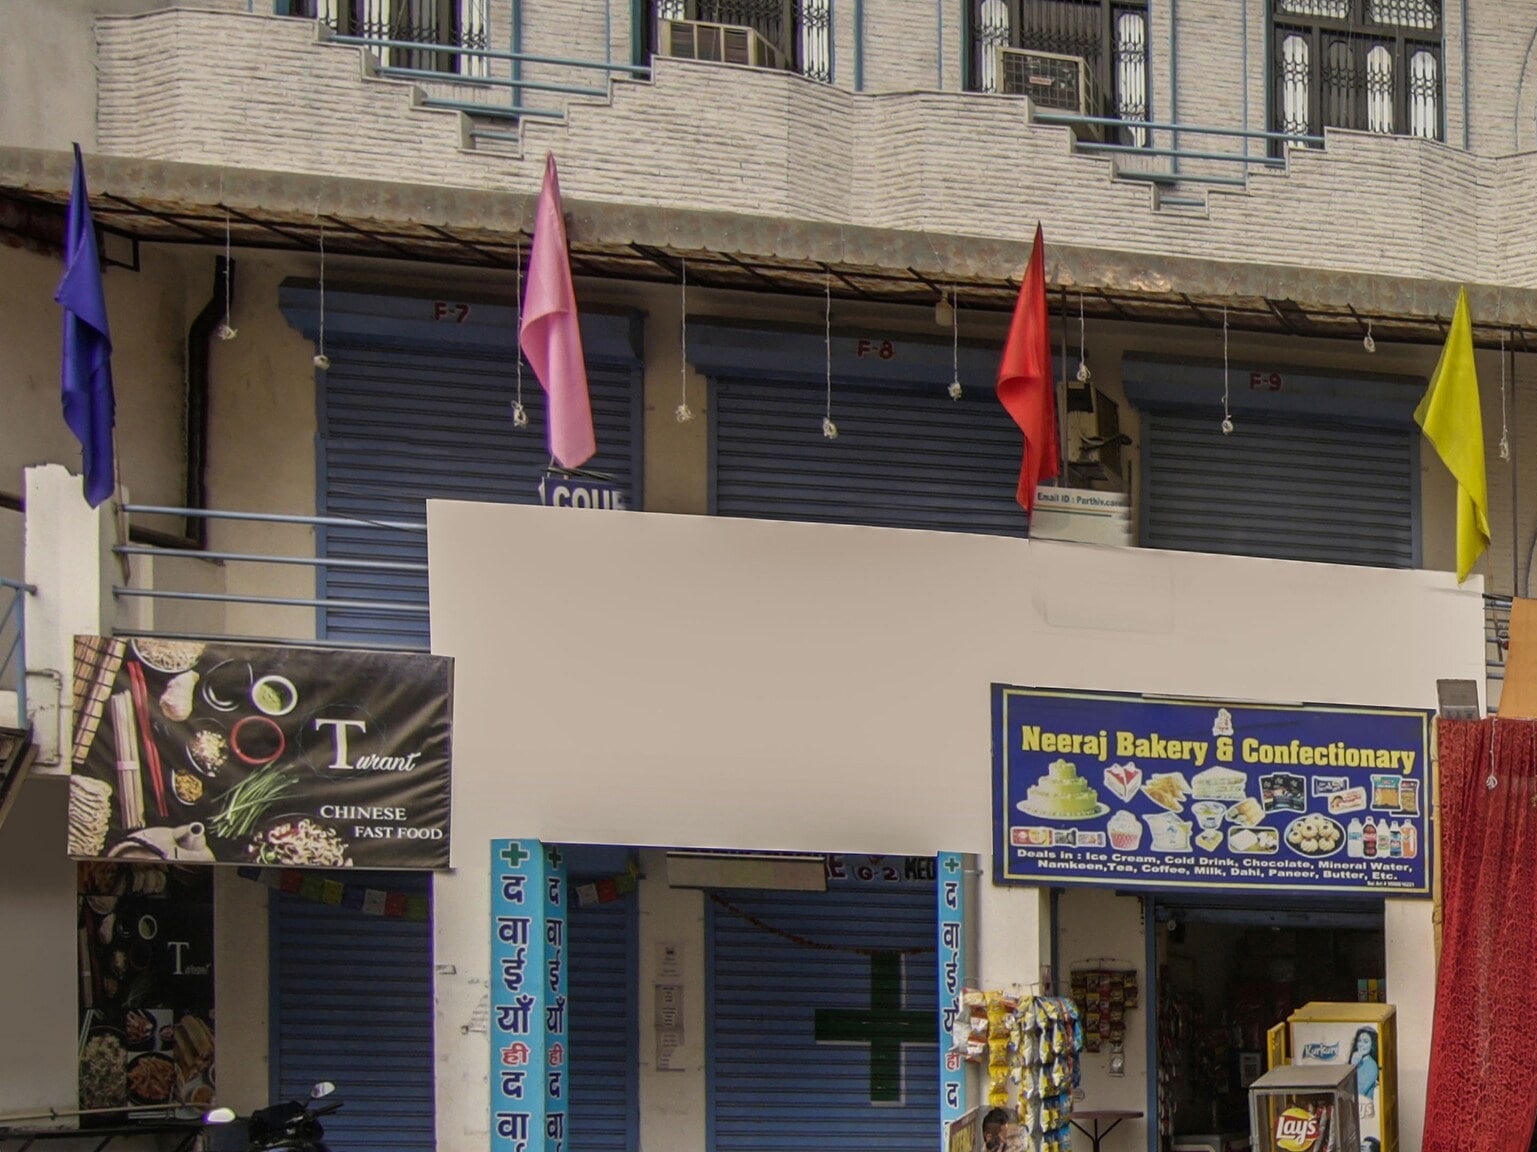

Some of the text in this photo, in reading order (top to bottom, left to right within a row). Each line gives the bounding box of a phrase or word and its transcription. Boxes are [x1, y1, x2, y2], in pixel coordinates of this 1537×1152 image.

[433, 302, 470, 323] F-7
[856, 340, 895, 360] F-8
[1249, 372, 1282, 391] F-9
[1037, 492, 1059, 502] Email
[1061, 495, 1070, 503] ID
[1021, 725, 1416, 774] Neeraj Bakery & Confectionary
[320, 805, 407, 820] CHINESE
[354, 826, 443, 839] FAST FOOD
[1017, 849, 1056, 858] Deals
[1060, 851, 1073, 859] in
[1086, 852, 1107, 861] Ice
[1112, 853, 1160, 864] Cream,
[1164, 856, 1195, 865] Cold
[1199, 857, 1238, 867] Drink,
[1242, 858, 1314, 869] Chocolate,
[1318, 860, 1366, 870] Mineral
[1370, 862, 1412, 872] Water,
[1142, 865, 1190, 875] Coffee,
[1194, 866, 1226, 876] Milk,
[1323, 871, 1367, 880] Butter,
[1372, 872, 1397, 880] Etc.
